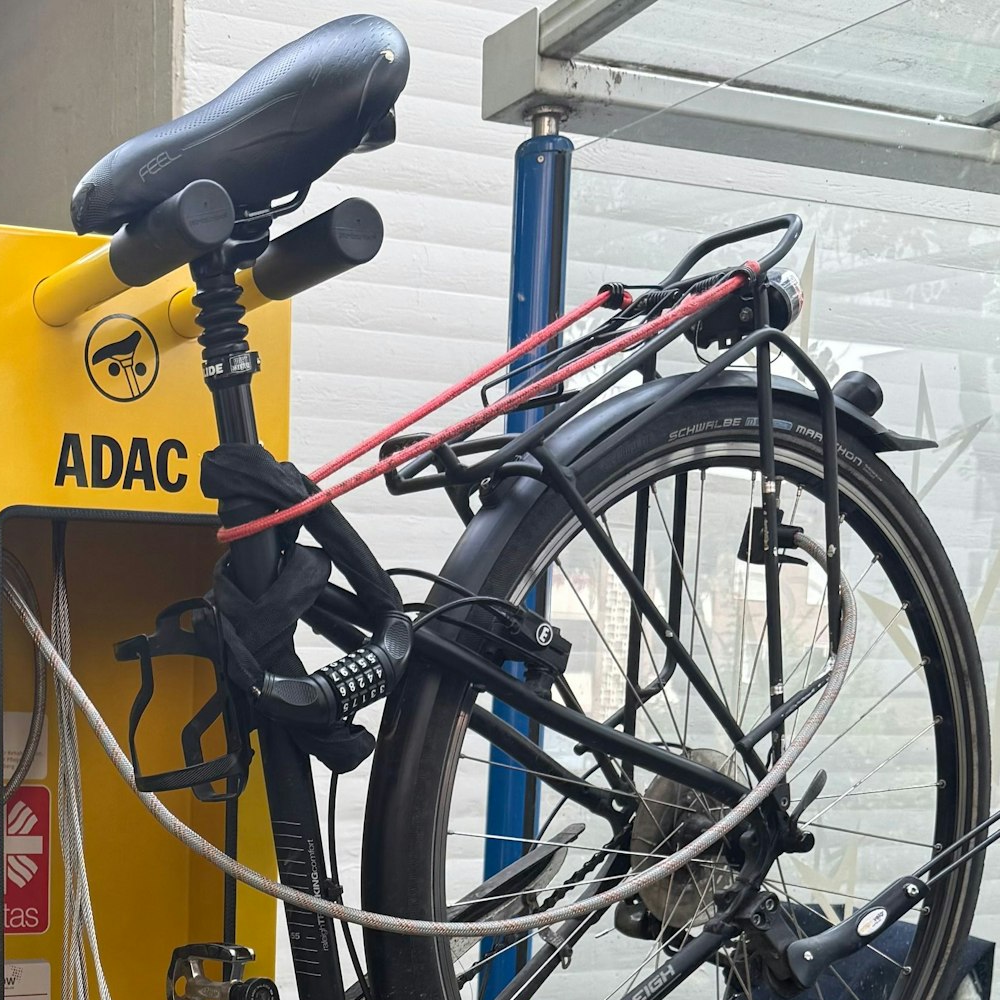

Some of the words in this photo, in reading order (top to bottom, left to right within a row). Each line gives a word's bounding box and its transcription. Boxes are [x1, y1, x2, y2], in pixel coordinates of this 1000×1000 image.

[138, 151, 182, 183] FEEL
[668, 417, 742, 442] SCHWALBE
[795, 424, 863, 467] MARHON
[54, 432, 189, 493] ADAC
